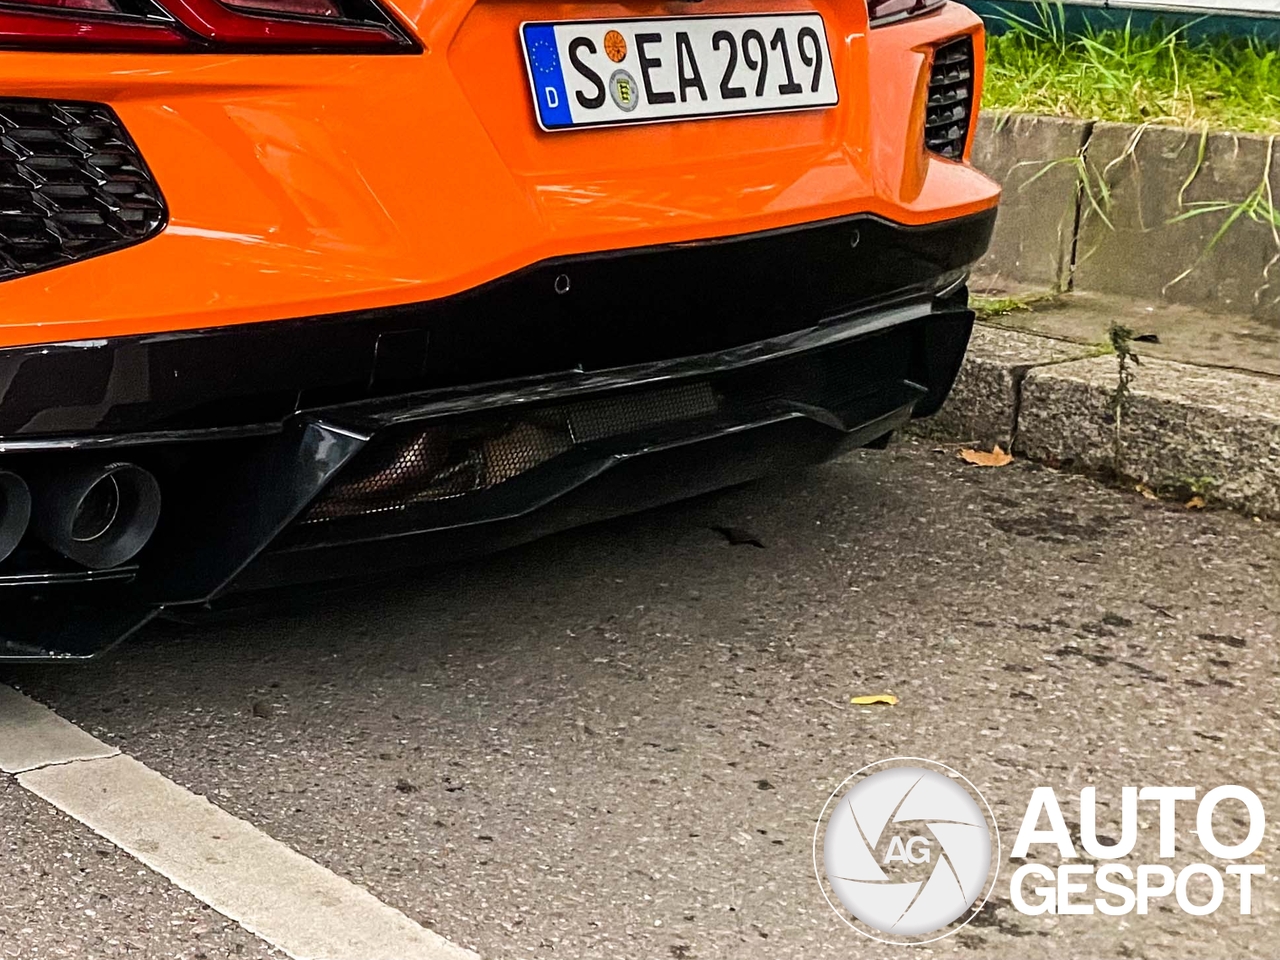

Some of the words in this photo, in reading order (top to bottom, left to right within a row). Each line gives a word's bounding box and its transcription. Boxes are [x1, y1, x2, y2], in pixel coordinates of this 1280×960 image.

[568, 36, 606, 109] S
[634, 31, 708, 105] EA
[712, 26, 823, 100] 2919
[545, 86, 559, 108] D
